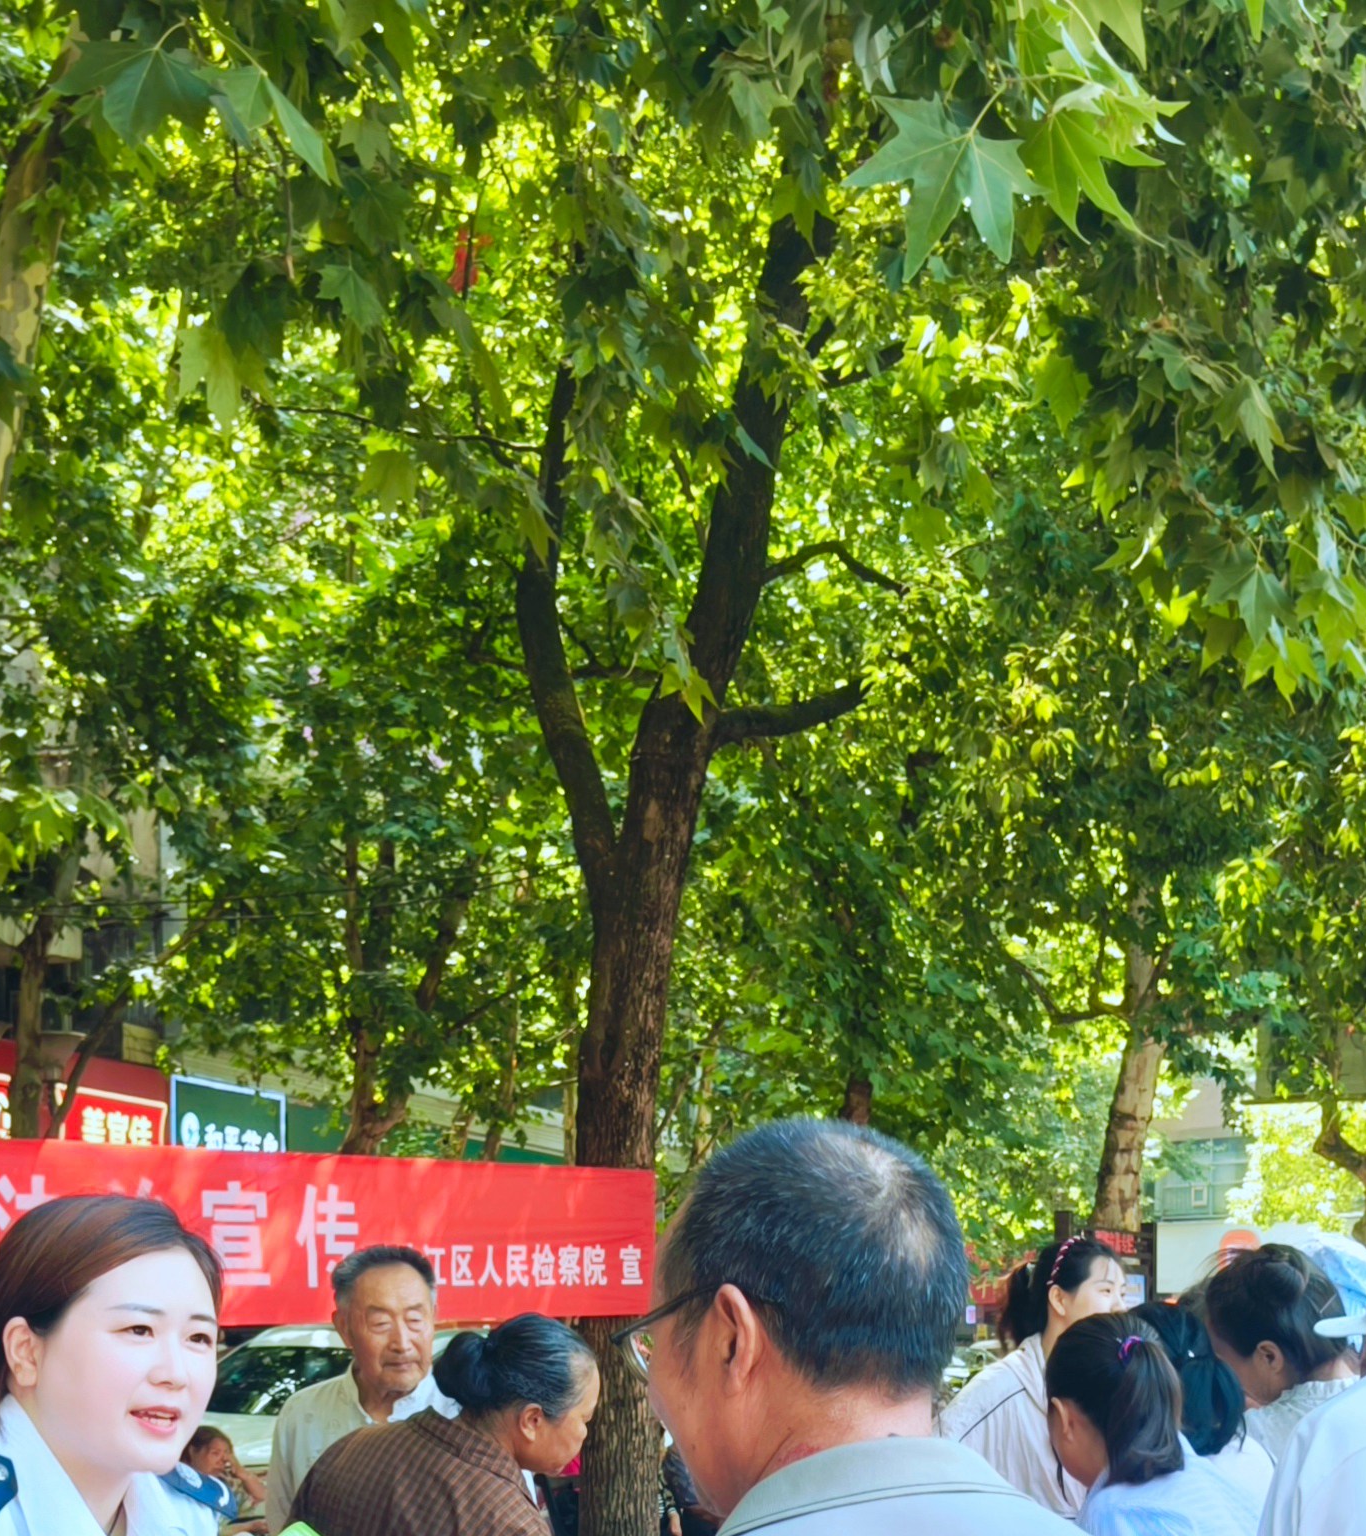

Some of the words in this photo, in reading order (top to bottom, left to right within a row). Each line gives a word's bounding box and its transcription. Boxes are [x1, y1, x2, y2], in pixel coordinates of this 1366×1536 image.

[408, 1243, 608, 1287] 江区人民检察院
[619, 1244, 643, 1285] 宣
